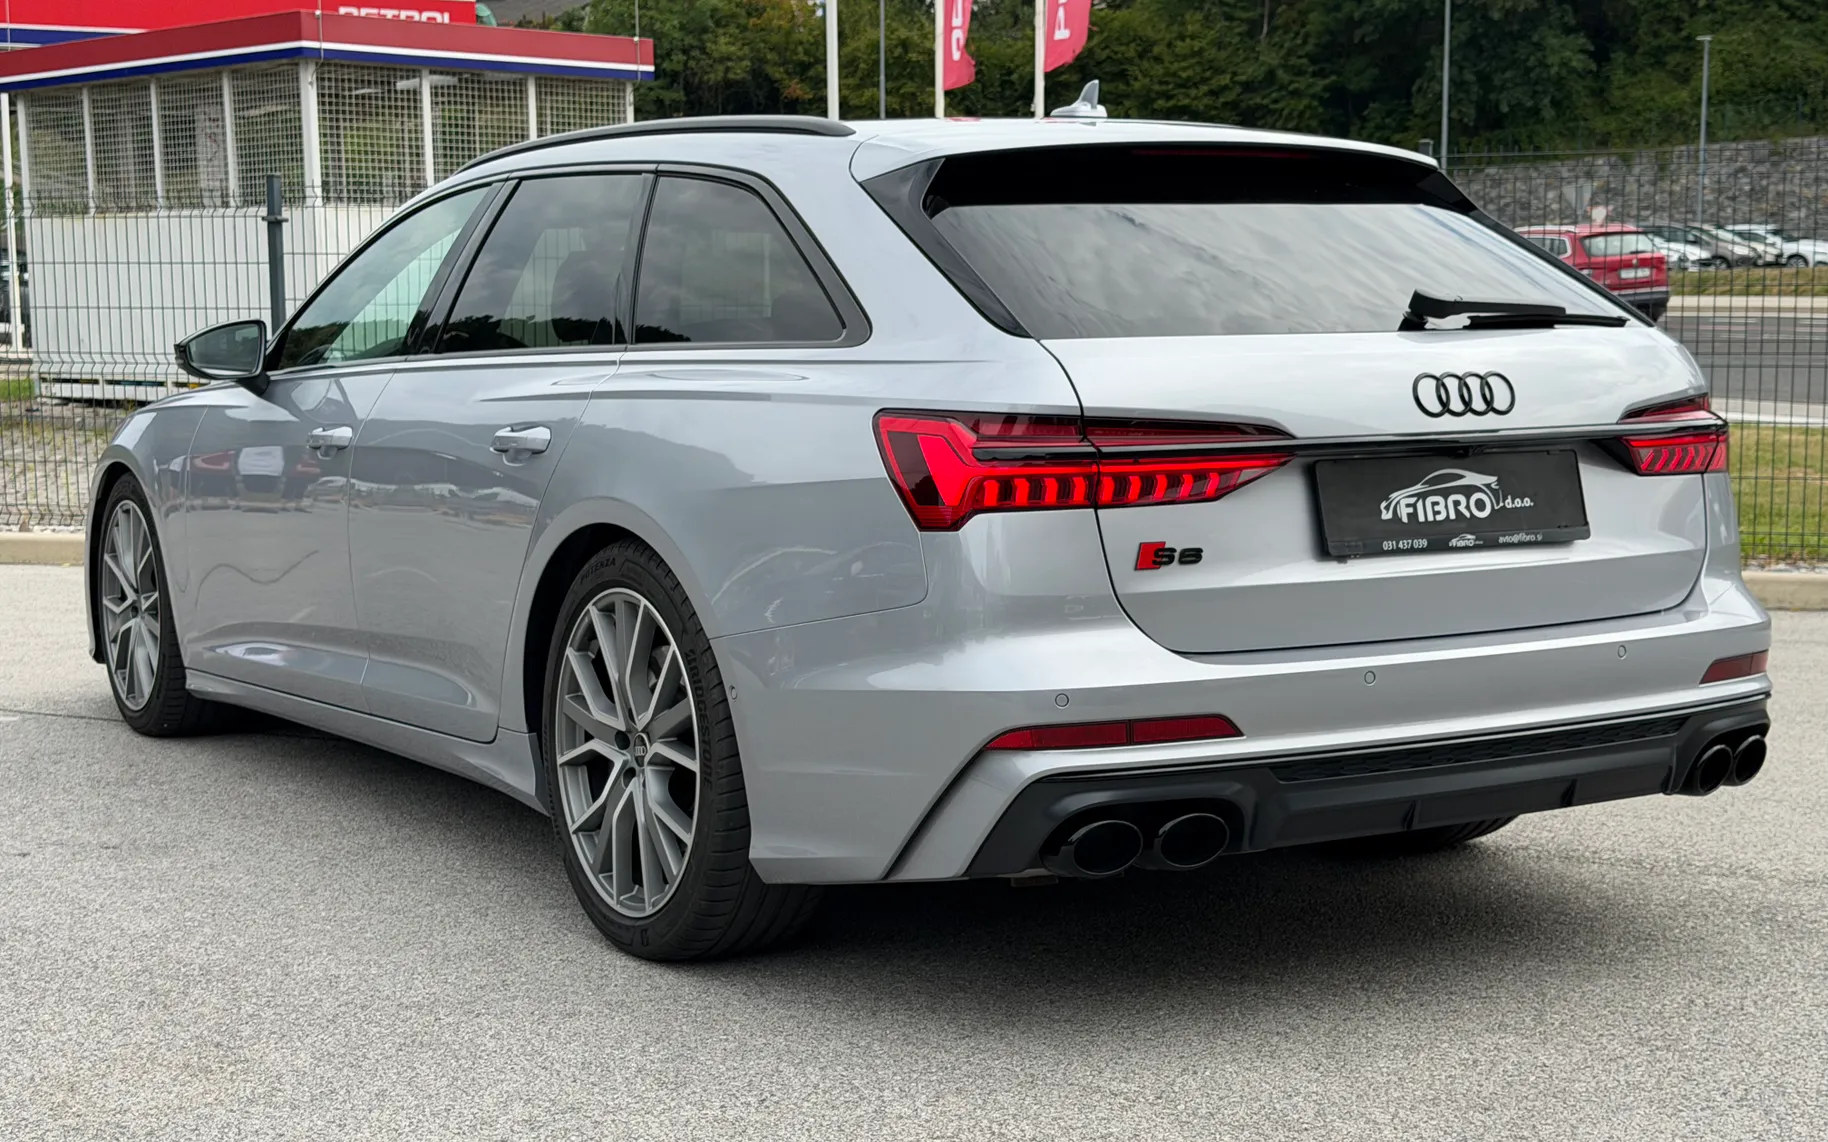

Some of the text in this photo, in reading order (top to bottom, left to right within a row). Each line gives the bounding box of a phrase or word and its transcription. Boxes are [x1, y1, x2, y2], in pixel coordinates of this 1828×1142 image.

[1399, 492, 1535, 523] FIBRO d.o.o.
[1382, 538, 1428, 551] 031 437 039
[1498, 532, 1543, 544] avto@fibro.si
[1151, 547, 1204, 566] S6
[684, 648, 712, 792] BRIDGESTONE
